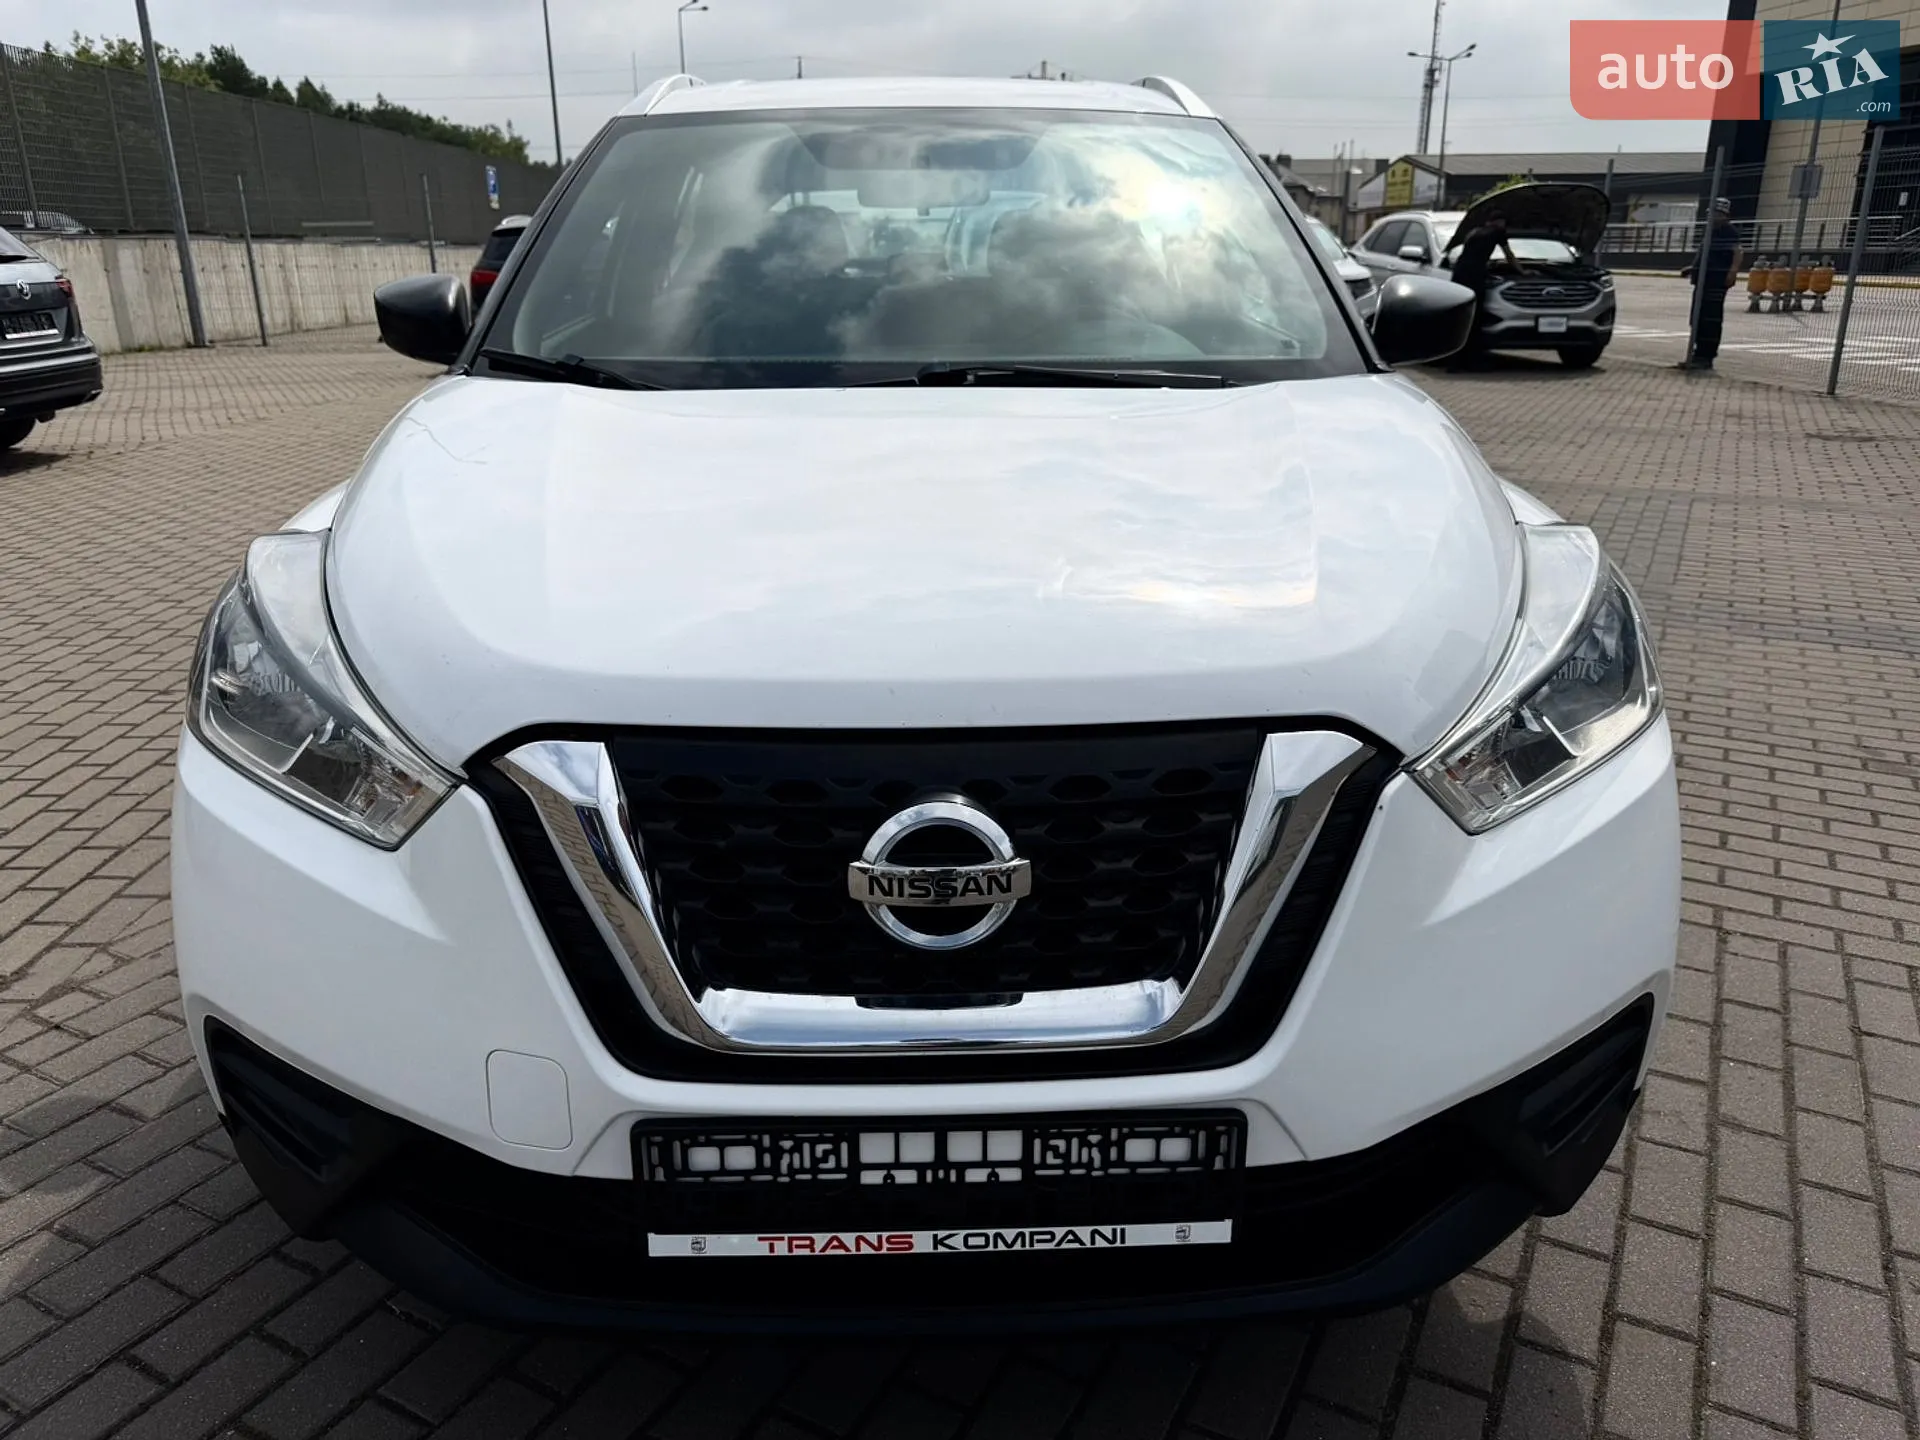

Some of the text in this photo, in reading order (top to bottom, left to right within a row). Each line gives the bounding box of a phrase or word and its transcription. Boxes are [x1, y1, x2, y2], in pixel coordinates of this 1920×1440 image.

[868, 873, 1012, 898] NISSAN
[757, 1227, 1126, 1254] TRANS KOMPANI
